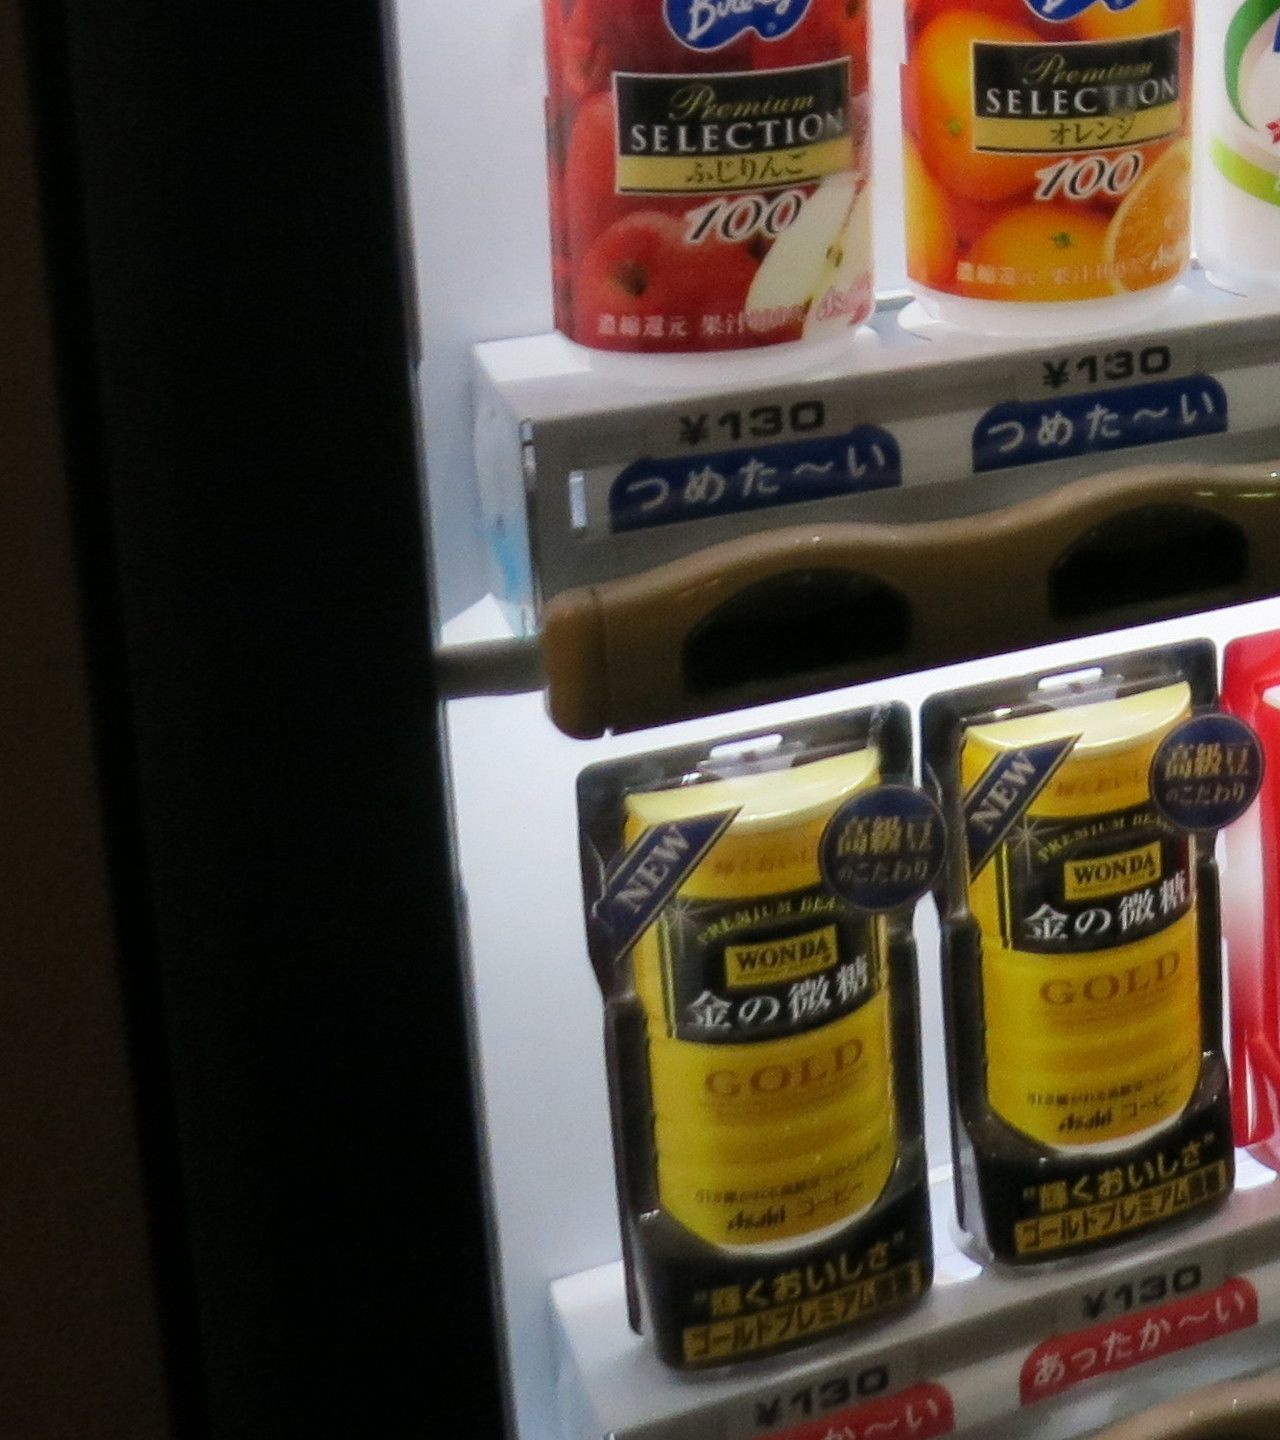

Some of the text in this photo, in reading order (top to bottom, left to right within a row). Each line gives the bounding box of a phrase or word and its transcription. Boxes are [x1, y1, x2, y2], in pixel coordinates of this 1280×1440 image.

[1021, 53, 1152, 87] Premium
[669, 84, 814, 121] Premium
[986, 75, 1176, 115] SELECTION
[630, 108, 843, 153] SELECTION
[1050, 116, 1135, 145] オレンジ
[685, 151, 812, 183] ふじりんご
[1034, 152, 1141, 200] 100
[1042, 346, 1172, 388] ¥130
[679, 401, 826, 444] ¥130
[969, 750, 1036, 834] NEW
[614, 825, 692, 911] NEW
[1073, 856, 1155, 885] WONDA
[737, 936, 830, 970] WONDA
[1040, 950, 1181, 1006] GOLD
[705, 1038, 863, 1096] GOLD
[1058, 1110, 1113, 1132] Asahi
[1081, 1266, 1201, 1318] ¥130
[1033, 1291, 1246, 1386] あったか〜い
[755, 1365, 889, 1426] ¥130
